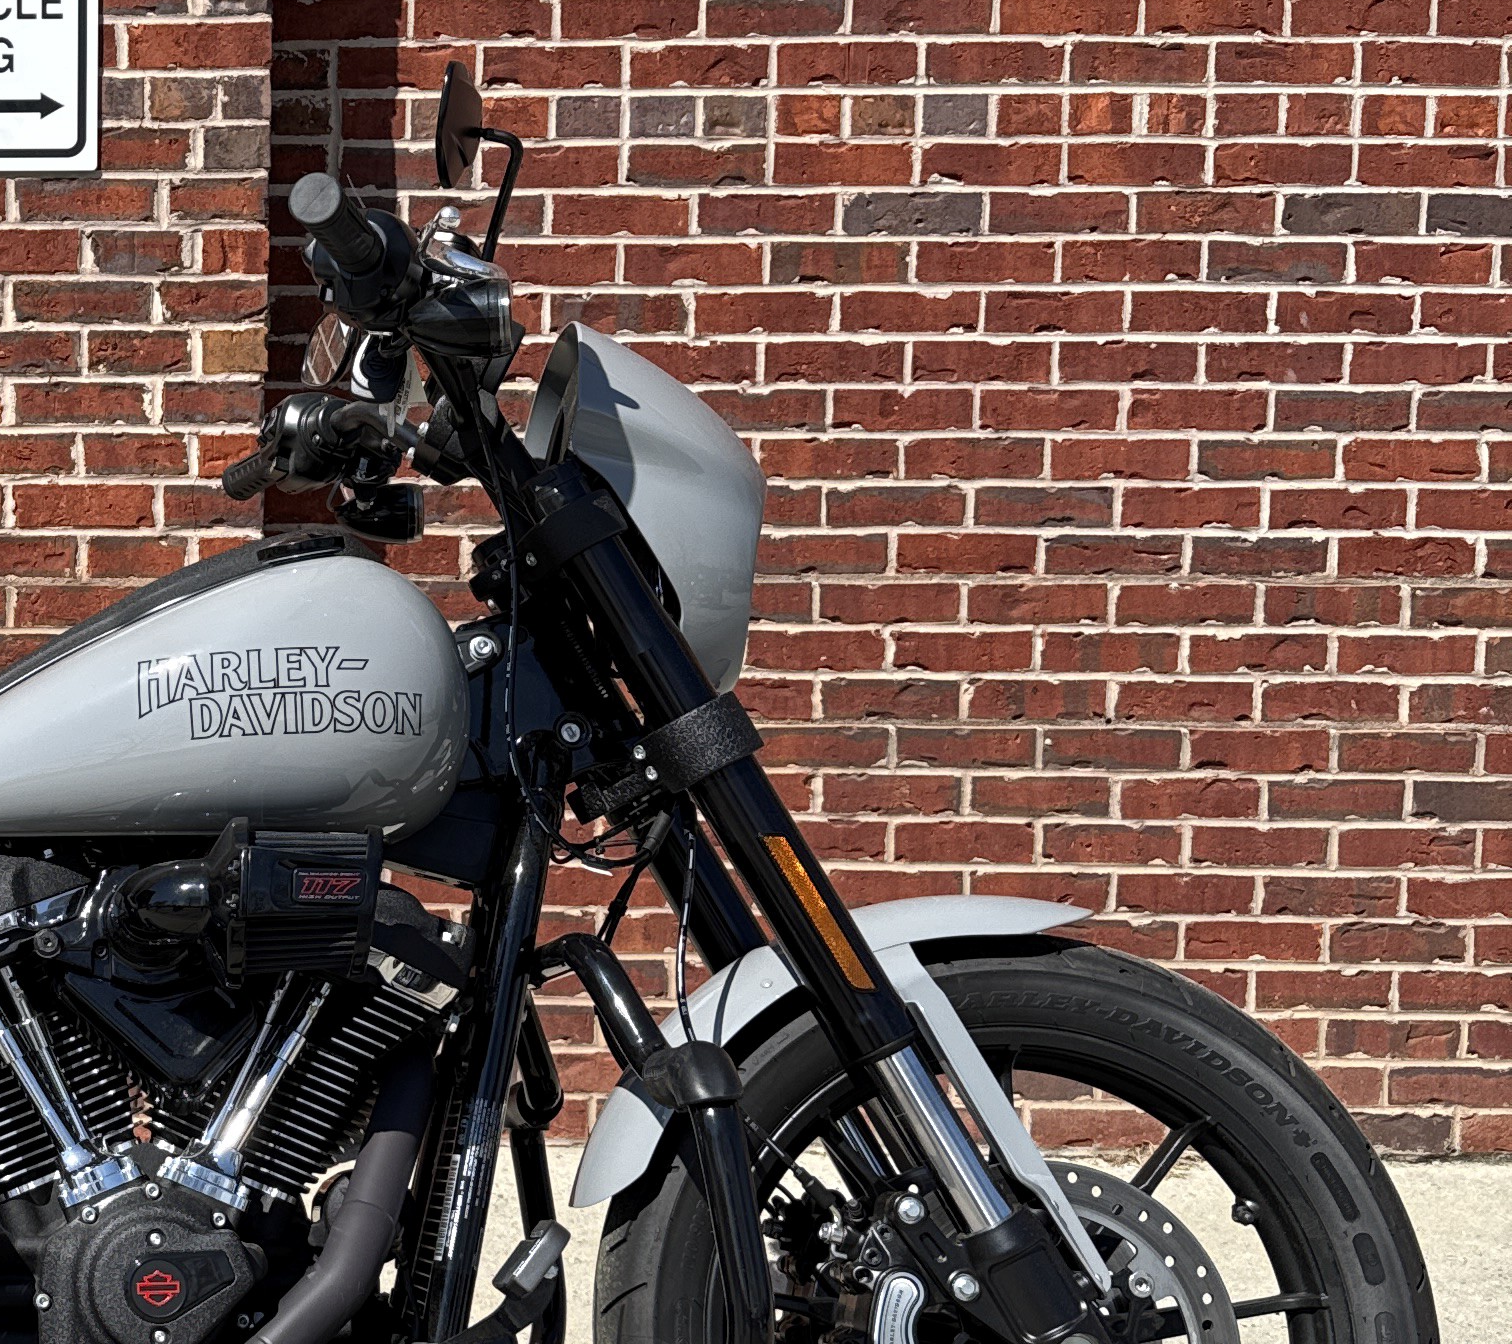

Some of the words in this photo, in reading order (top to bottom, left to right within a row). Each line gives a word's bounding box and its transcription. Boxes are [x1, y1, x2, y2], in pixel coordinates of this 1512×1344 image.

[138, 646, 369, 719] HARLEY-
[188, 690, 423, 740] DAVIDSON
[300, 877, 361, 894] 117
[952, 990, 1299, 1127] ARLEY-DAVIDSON
